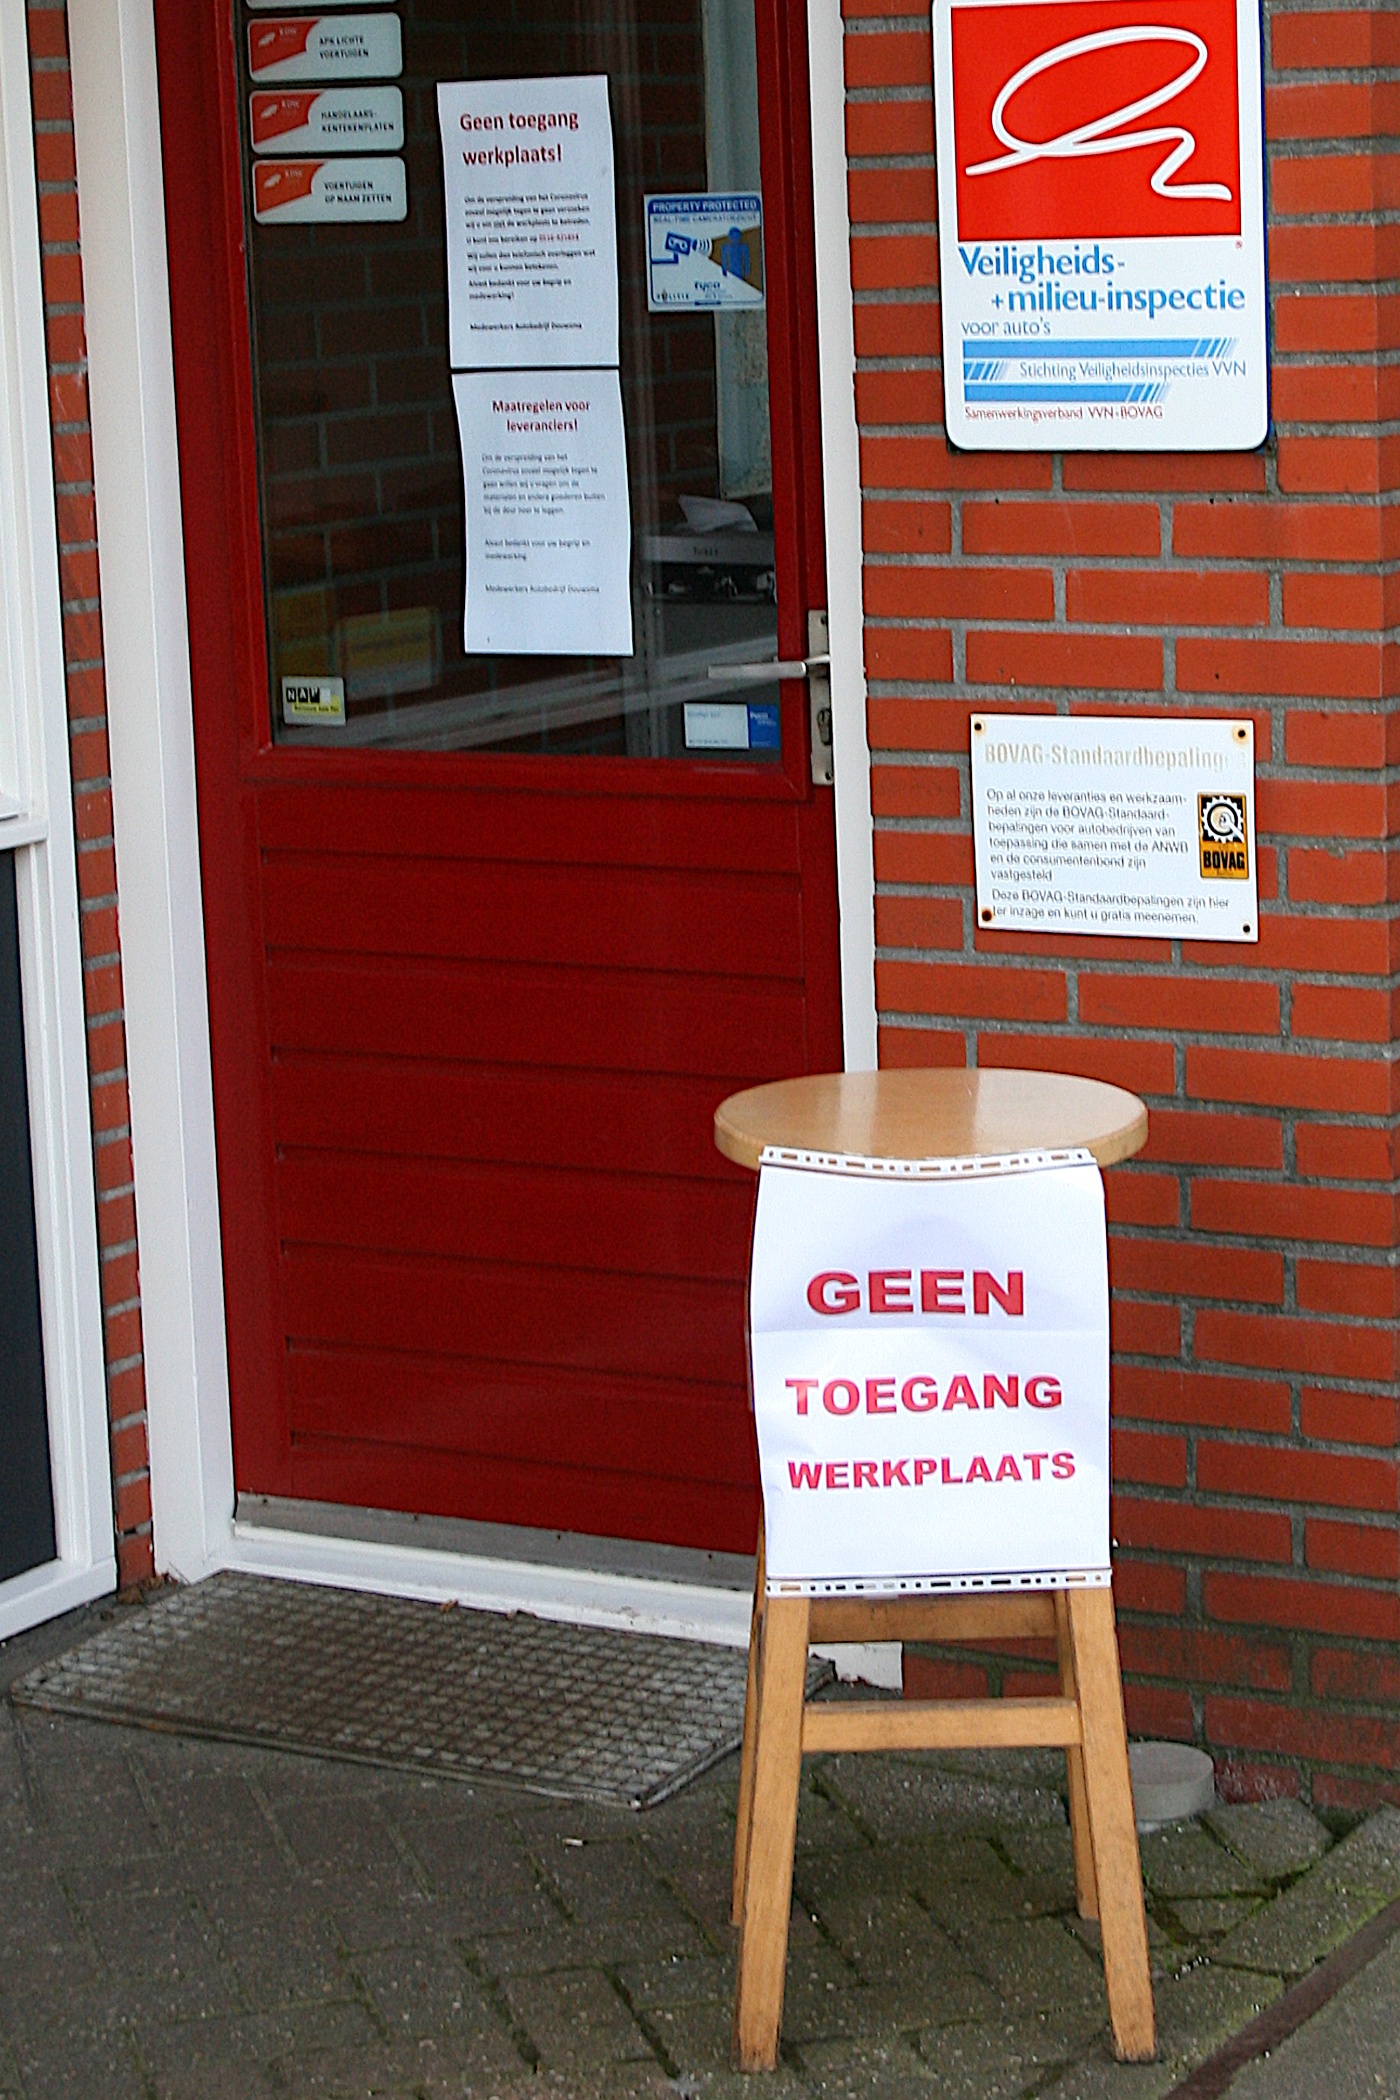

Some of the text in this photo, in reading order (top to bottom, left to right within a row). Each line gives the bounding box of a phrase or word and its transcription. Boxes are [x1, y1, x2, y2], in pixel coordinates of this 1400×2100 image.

[460, 112, 579, 132] Geen toegang
[462, 143, 562, 168] werkplaats!
[337, 195, 360, 203] NAAM
[362, 194, 391, 203] ZETTEN
[653, 200, 757, 212] PROPERTY PROTECTED
[959, 244, 1125, 284] Veiligheids-
[961, 317, 1051, 335] voor auto's
[1019, 361, 1246, 383] Stichting Veiligheidsinspecties VVN
[492, 399, 590, 414] Maatregelen voor
[964, 406, 1083, 423] Samenwerkingsverband
[506, 418, 578, 432] leveranciers!
[986, 788, 1187, 805] Op al onze leveranties en werkzaam-
[987, 806, 1022, 817] heden
[1024, 806, 1043, 820] zijn
[1045, 807, 1059, 818] de
[989, 821, 1175, 839] bepalingen voor autobedrijven van
[989, 837, 1188, 853] toepassing die samen met de ANWB
[990, 854, 1146, 871] en de consumentenbond zijn
[1203, 850, 1245, 870] BOVAG
[990, 868, 1052, 882] vastgesteld
[992, 889, 1019, 901] Deze
[1187, 896, 1206, 910] zijn
[1208, 896, 1229, 908] hier
[1010, 906, 1045, 920] inzage
[1048, 909, 1061, 918] en
[1064, 907, 1088, 919] kunt
[1091, 911, 1098, 919] u
[1101, 909, 1131, 923] gratis
[1134, 911, 1199, 924] meenemen.
[807, 1269, 1024, 1316] GEEN
[785, 1374, 1062, 1416] TOEGANG
[787, 1451, 1076, 1490] WERKPLAATS
